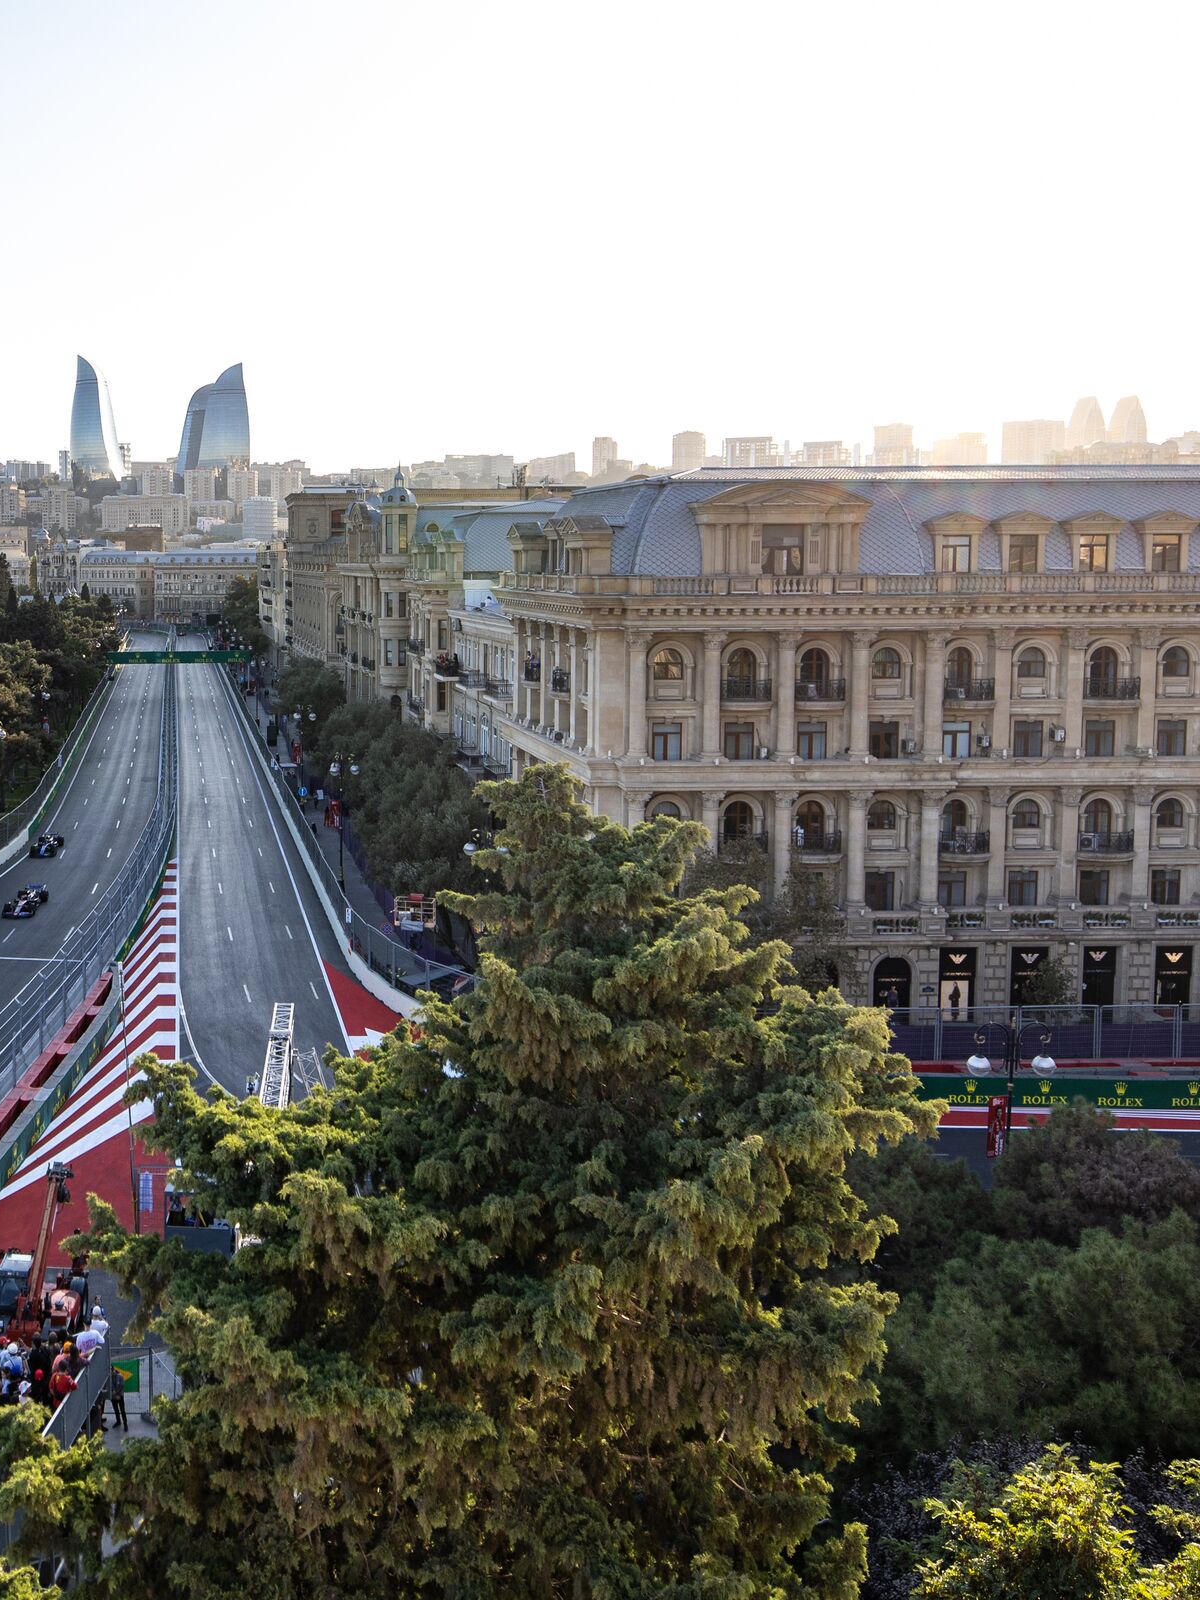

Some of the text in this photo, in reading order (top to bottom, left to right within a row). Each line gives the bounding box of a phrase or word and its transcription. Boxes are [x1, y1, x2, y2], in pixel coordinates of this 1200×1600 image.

[948, 1095, 990, 1104] ROLEX
[1023, 1096, 1068, 1105] ROLEX
[1098, 1097, 1143, 1107] ROLEX
